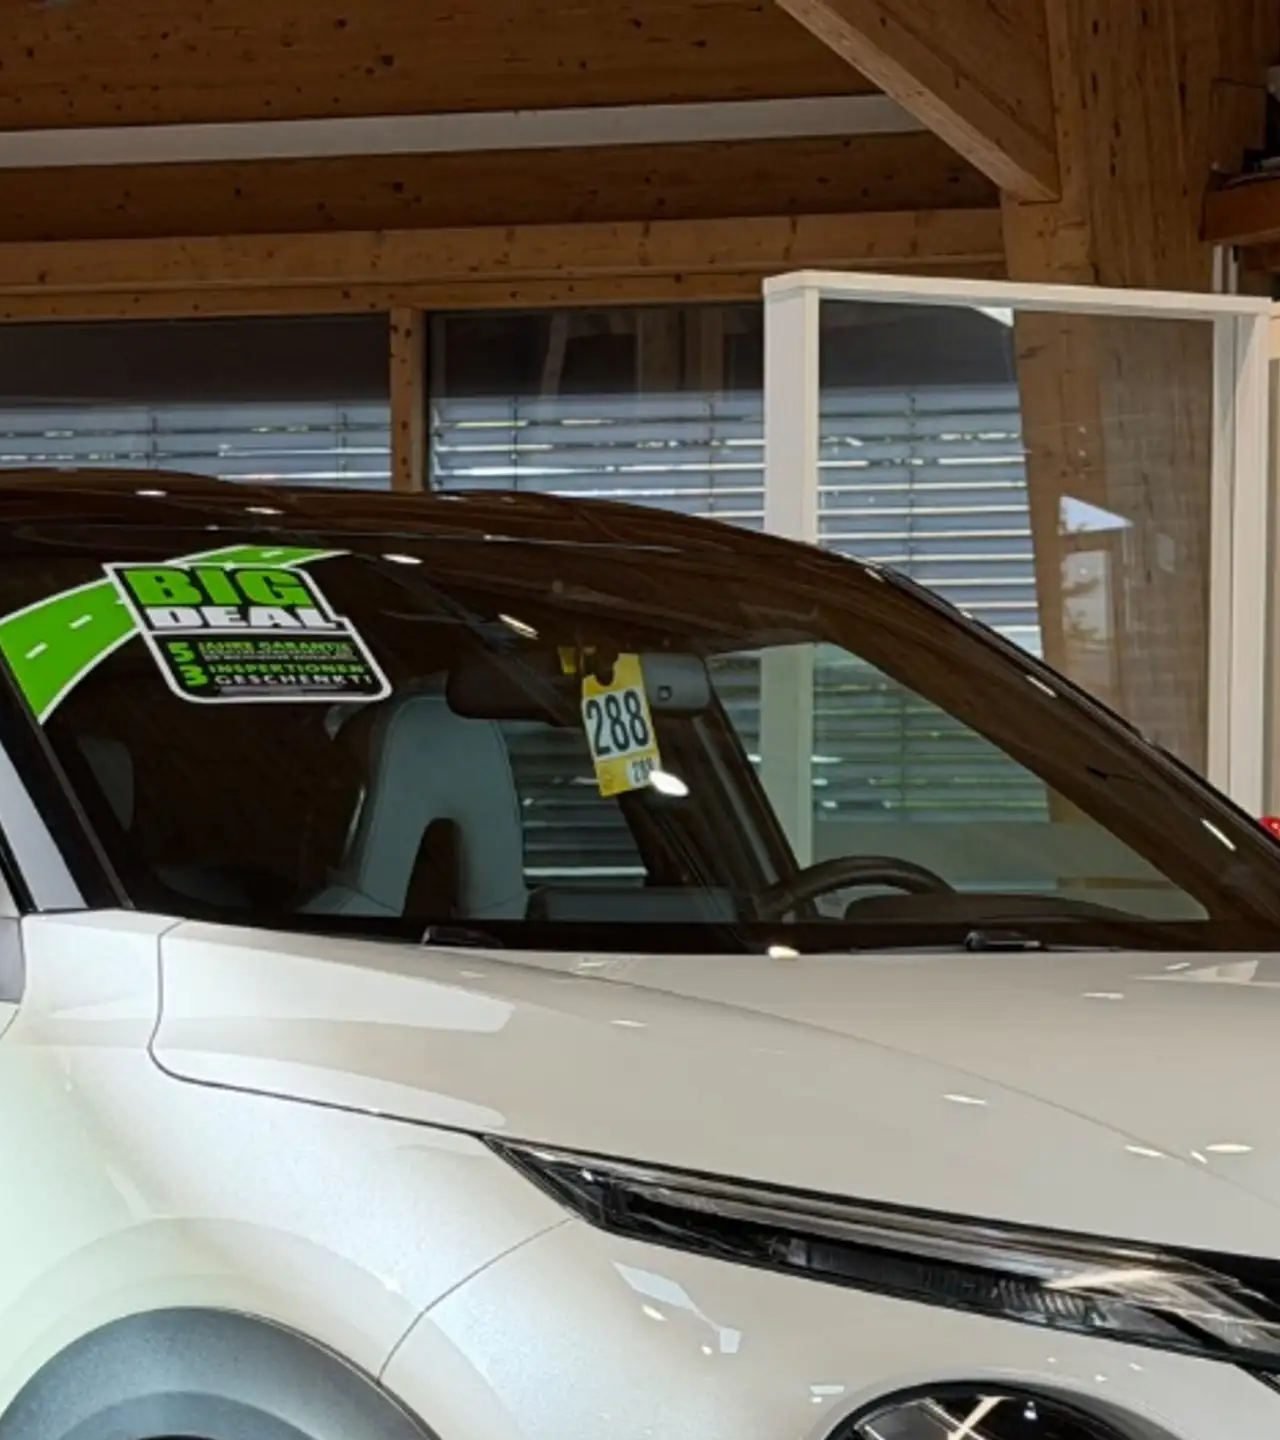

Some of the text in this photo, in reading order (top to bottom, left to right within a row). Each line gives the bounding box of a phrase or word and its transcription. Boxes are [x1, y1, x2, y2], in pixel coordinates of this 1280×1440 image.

[123, 569, 314, 606] BIG
[144, 606, 337, 629] DEAL
[167, 641, 195, 662] 5
[179, 664, 208, 687] 3
[586, 688, 650, 756] 288
